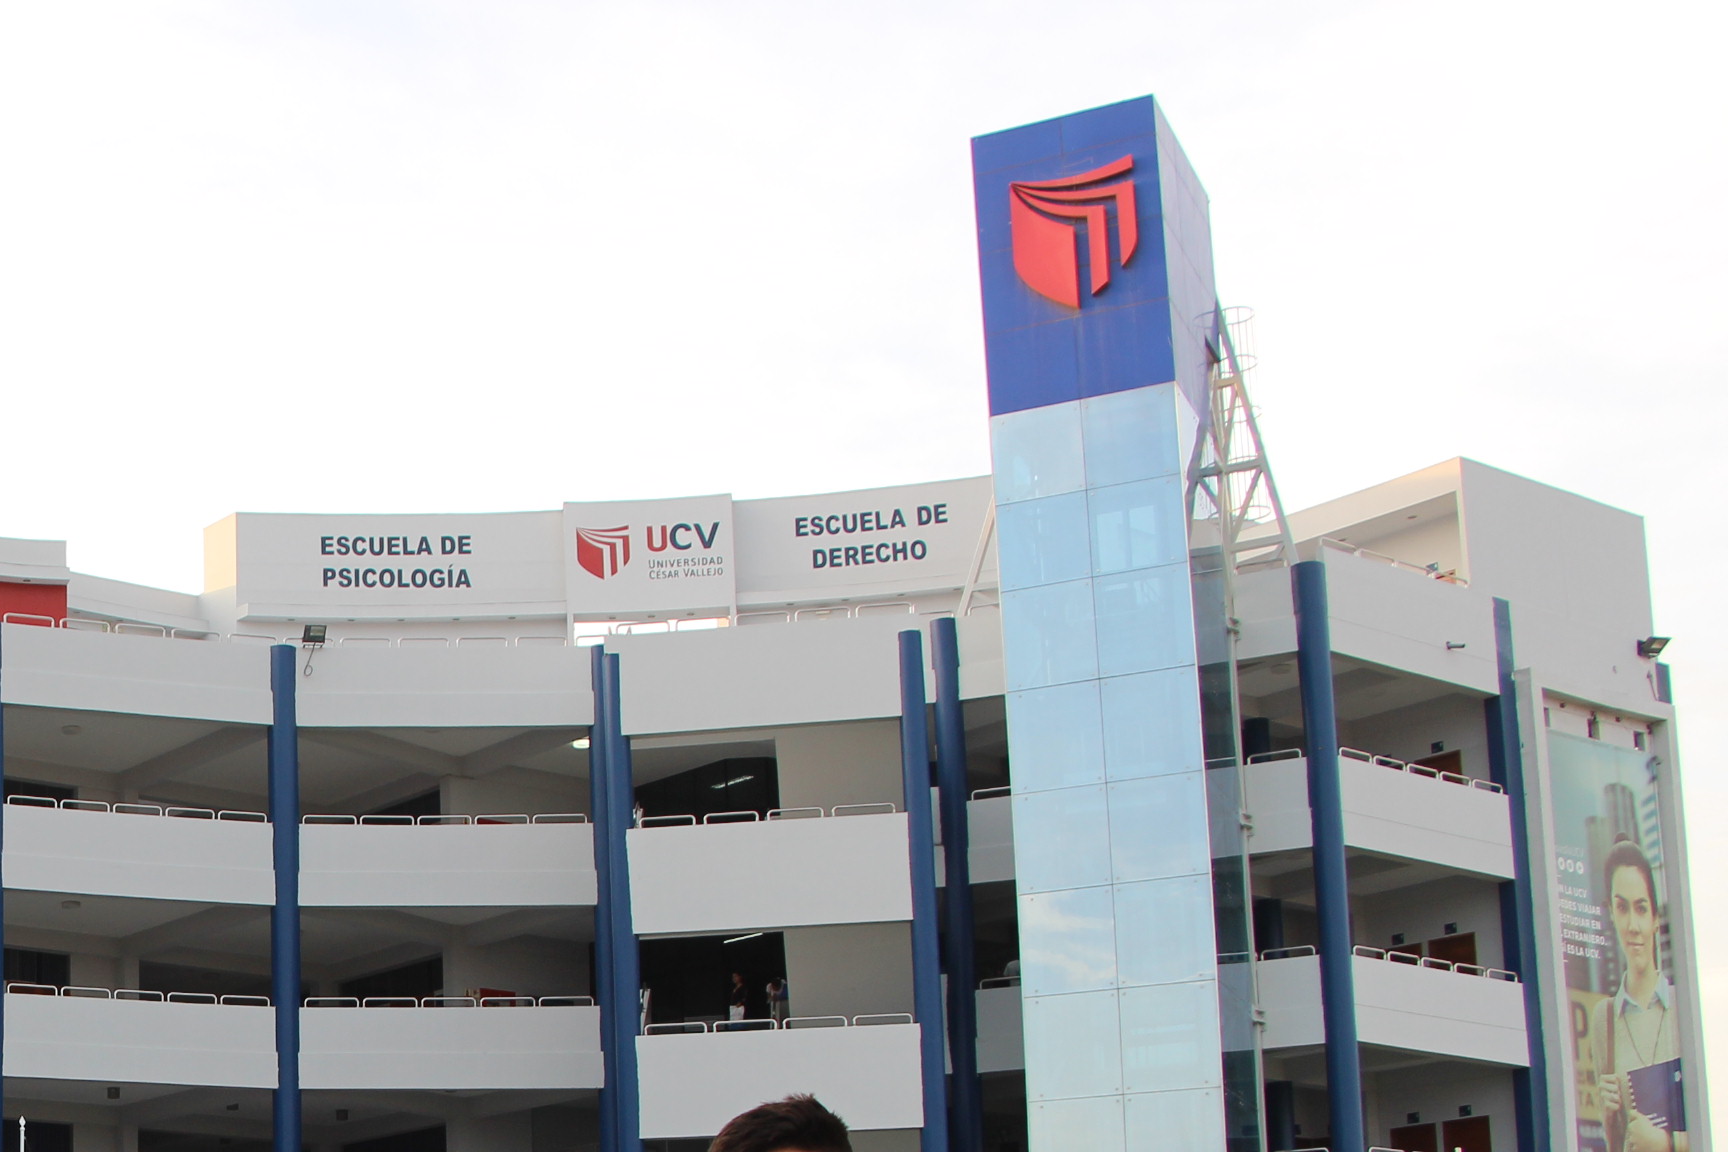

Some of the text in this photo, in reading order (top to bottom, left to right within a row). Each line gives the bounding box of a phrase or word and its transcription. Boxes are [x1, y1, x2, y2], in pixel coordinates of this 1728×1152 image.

[795, 503, 948, 537] ESCUELA DE
[321, 535, 472, 556] ESCUELA DE
[646, 521, 720, 552] UCV
[648, 556, 723, 569] UNIVERSIDAD
[812, 539, 927, 569] DERECHO
[322, 563, 472, 588] PSICOLOGÍA
[649, 567, 724, 580] CÉSAR VALLEJO
